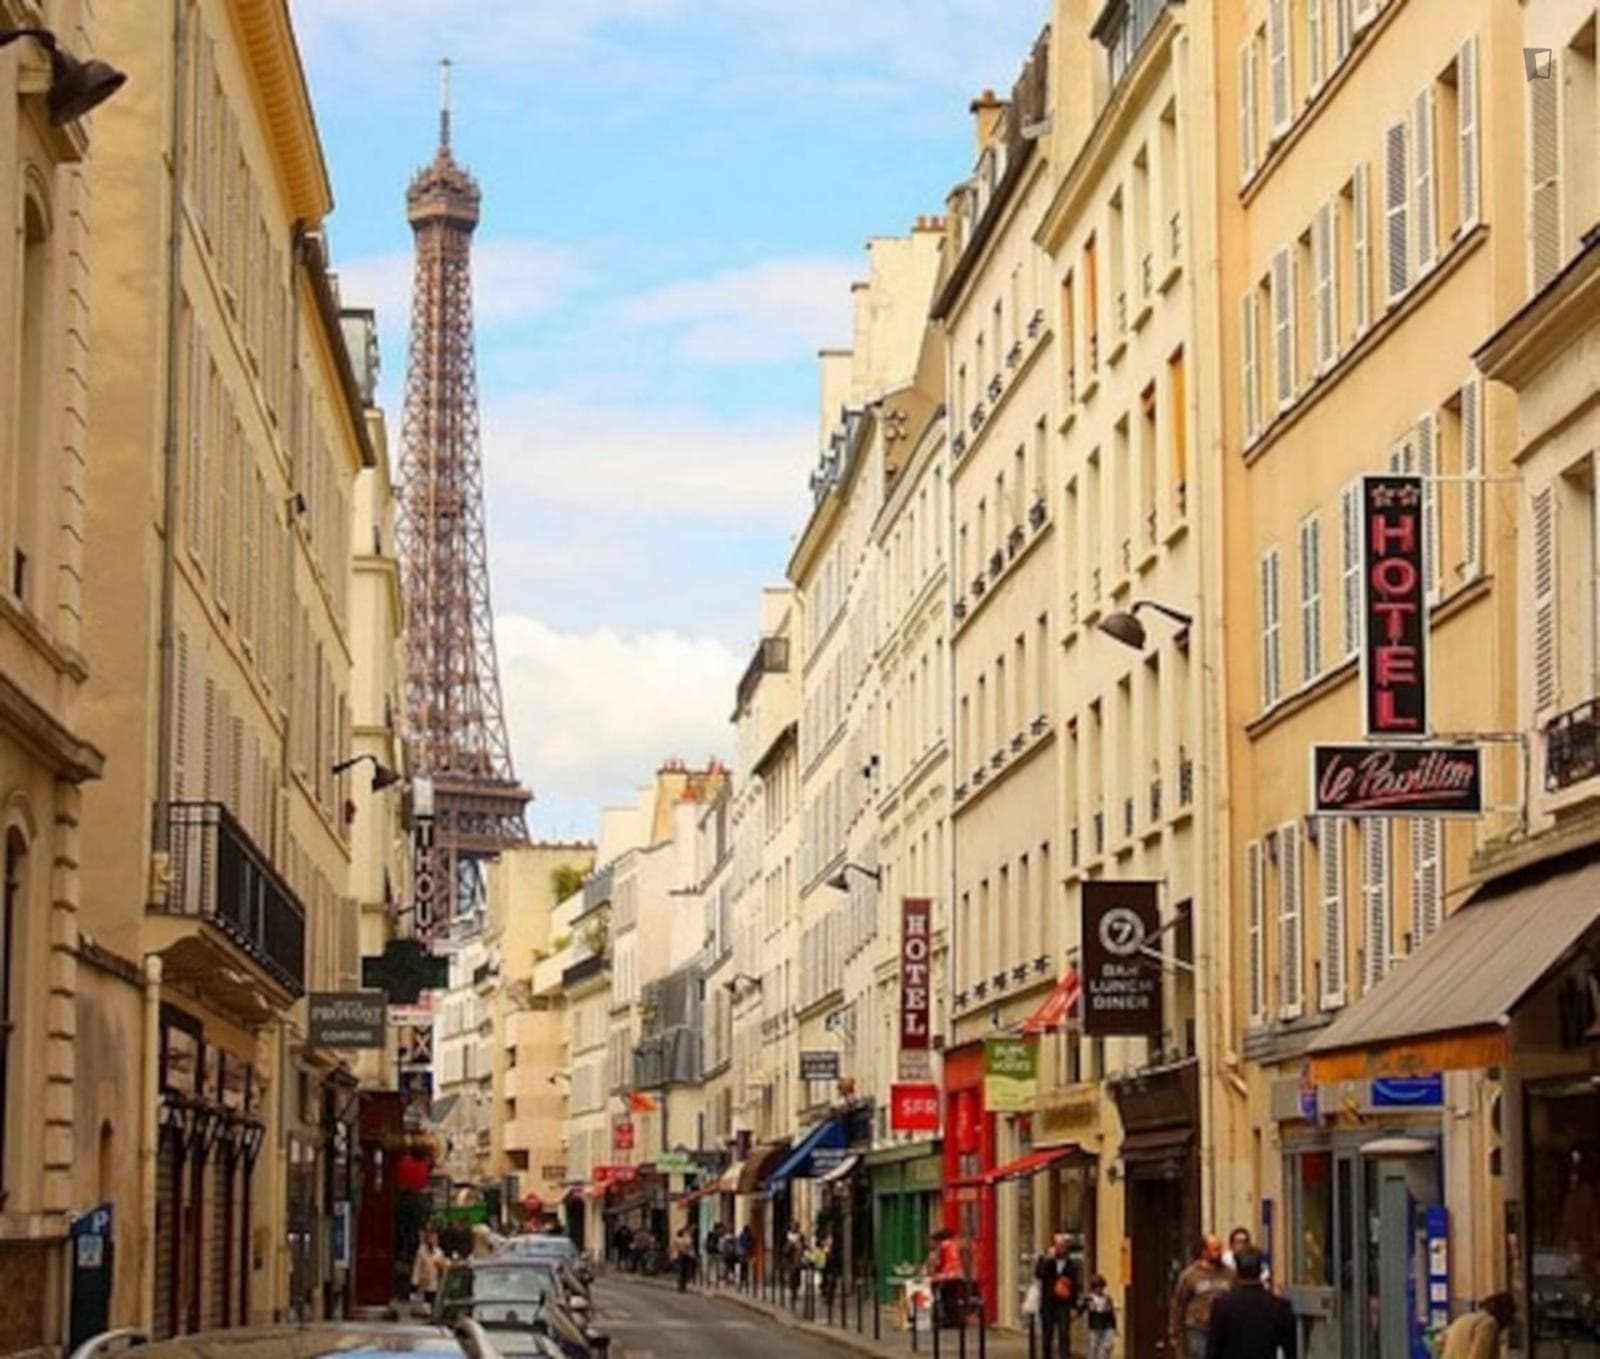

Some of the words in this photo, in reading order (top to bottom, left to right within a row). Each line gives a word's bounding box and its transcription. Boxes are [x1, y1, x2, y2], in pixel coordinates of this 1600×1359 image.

[1371, 514, 1418, 729] HOTEL
[1358, 750, 1474, 798] Pavillon
[905, 914, 928, 1036] HOTEL
[1089, 979, 1153, 994] LUNCH
[1093, 995, 1149, 1010] DINER
[902, 1098, 938, 1117] SFR
